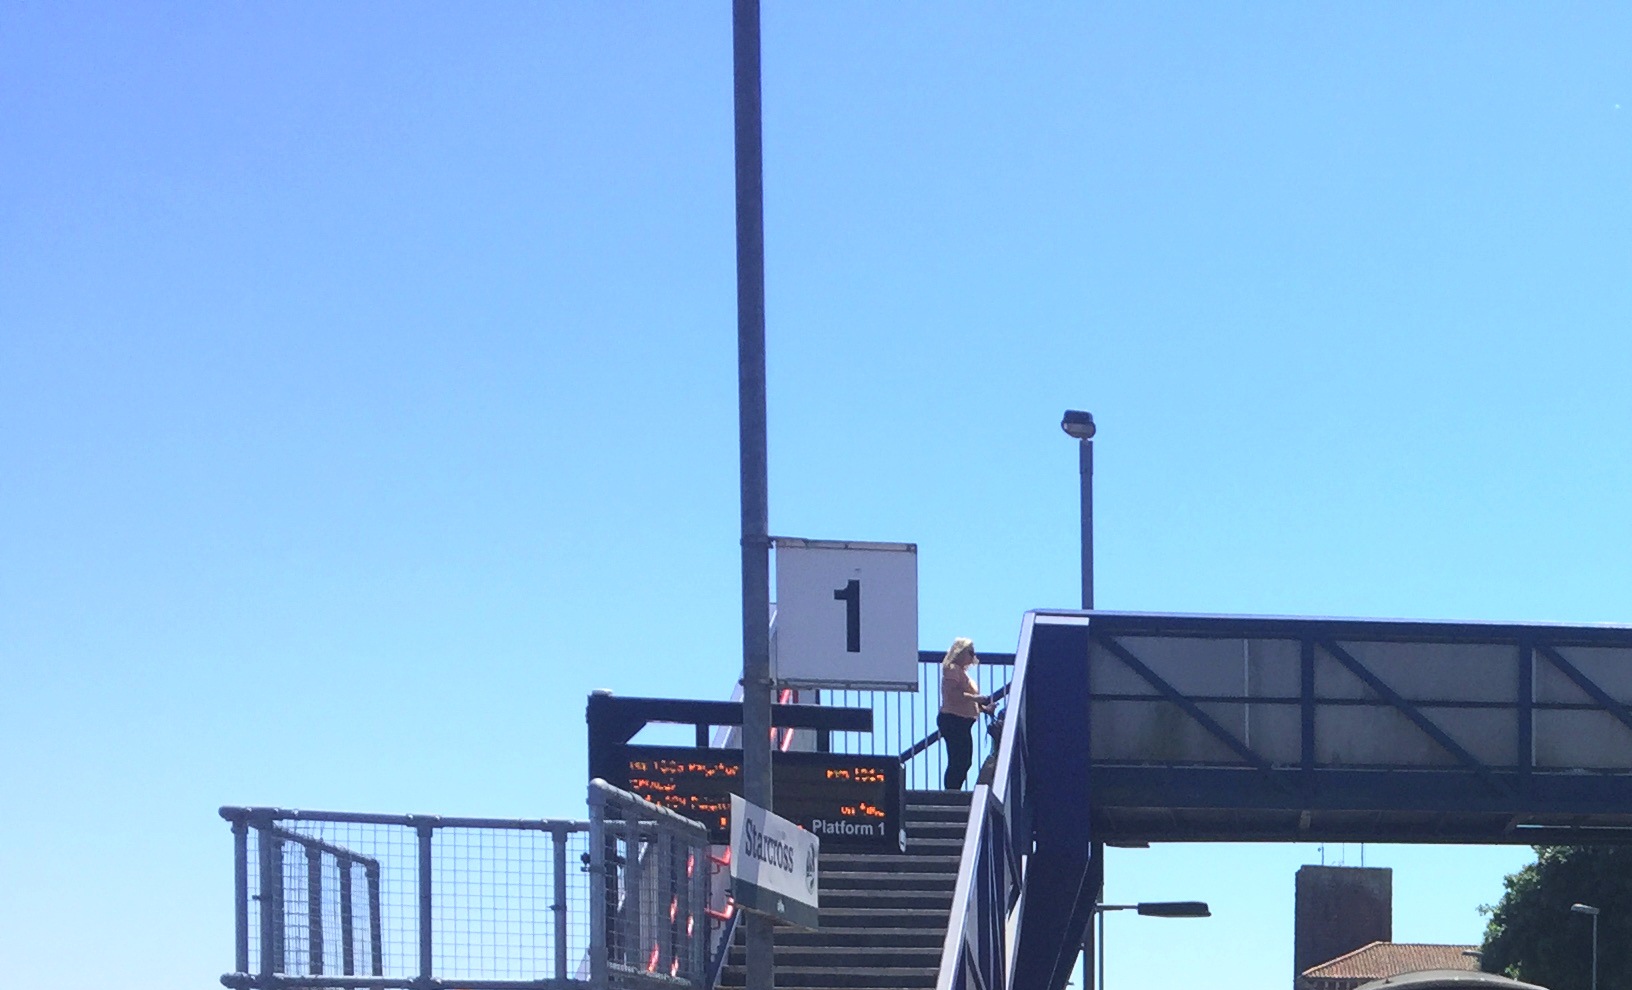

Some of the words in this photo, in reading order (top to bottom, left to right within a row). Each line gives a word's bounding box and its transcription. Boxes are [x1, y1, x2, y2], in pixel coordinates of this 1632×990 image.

[834, 579, 860, 652] 1
[745, 818, 794, 873] Starcross
[813, 819, 873, 836] Platform
[878, 822, 885, 836] 1
